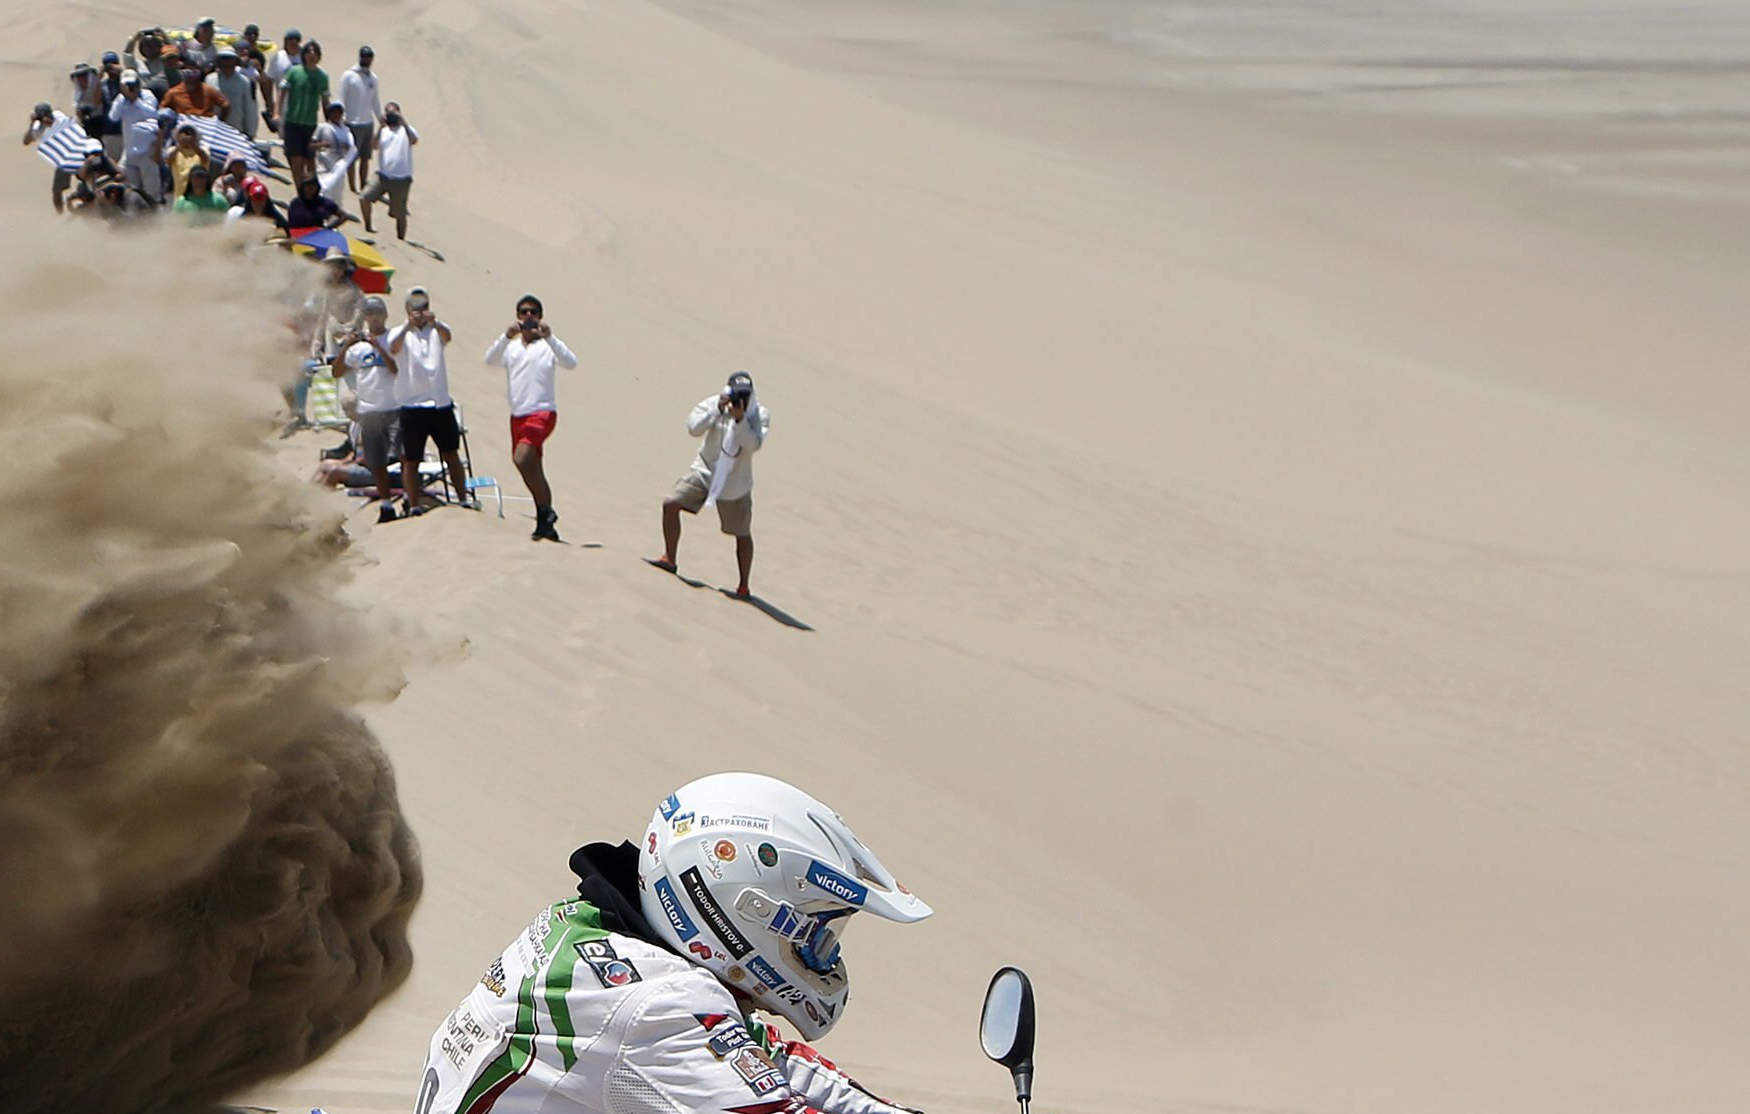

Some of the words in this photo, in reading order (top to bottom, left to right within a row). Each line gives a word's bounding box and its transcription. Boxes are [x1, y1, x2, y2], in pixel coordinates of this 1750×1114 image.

[693, 884, 717, 918] TODOR
[711, 913, 741, 945] HRISTOV
[448, 1015, 474, 1057] ENTINA
[461, 1012, 490, 1043] PERU
[441, 1037, 467, 1072] CHILE
